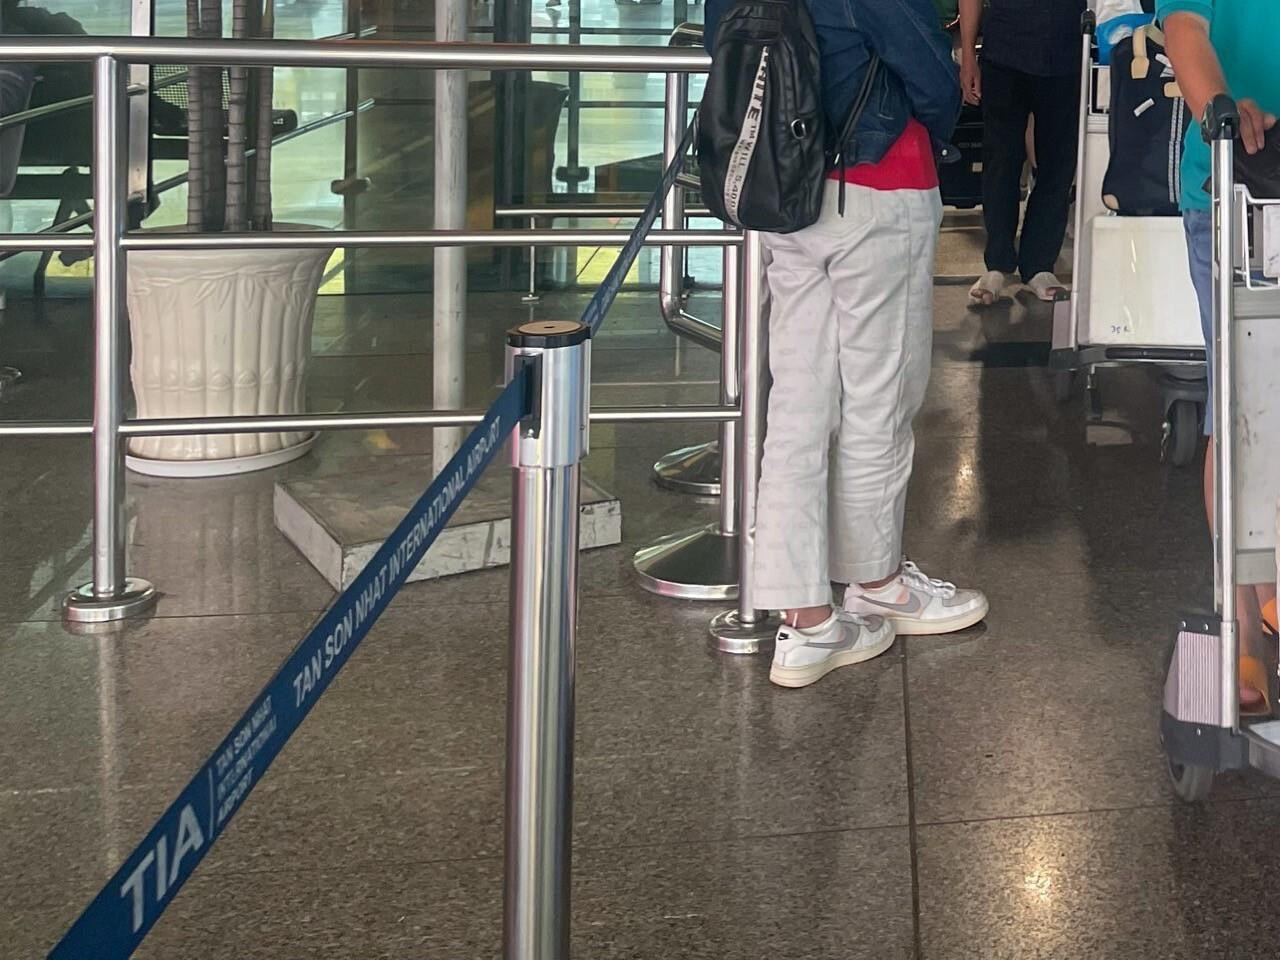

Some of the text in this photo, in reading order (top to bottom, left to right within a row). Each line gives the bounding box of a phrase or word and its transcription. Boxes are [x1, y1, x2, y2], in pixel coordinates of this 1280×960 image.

[293, 415, 501, 708] TAN SON NHAT INTERNATIONAL AIRPORT
[120, 802, 205, 934] TIA
